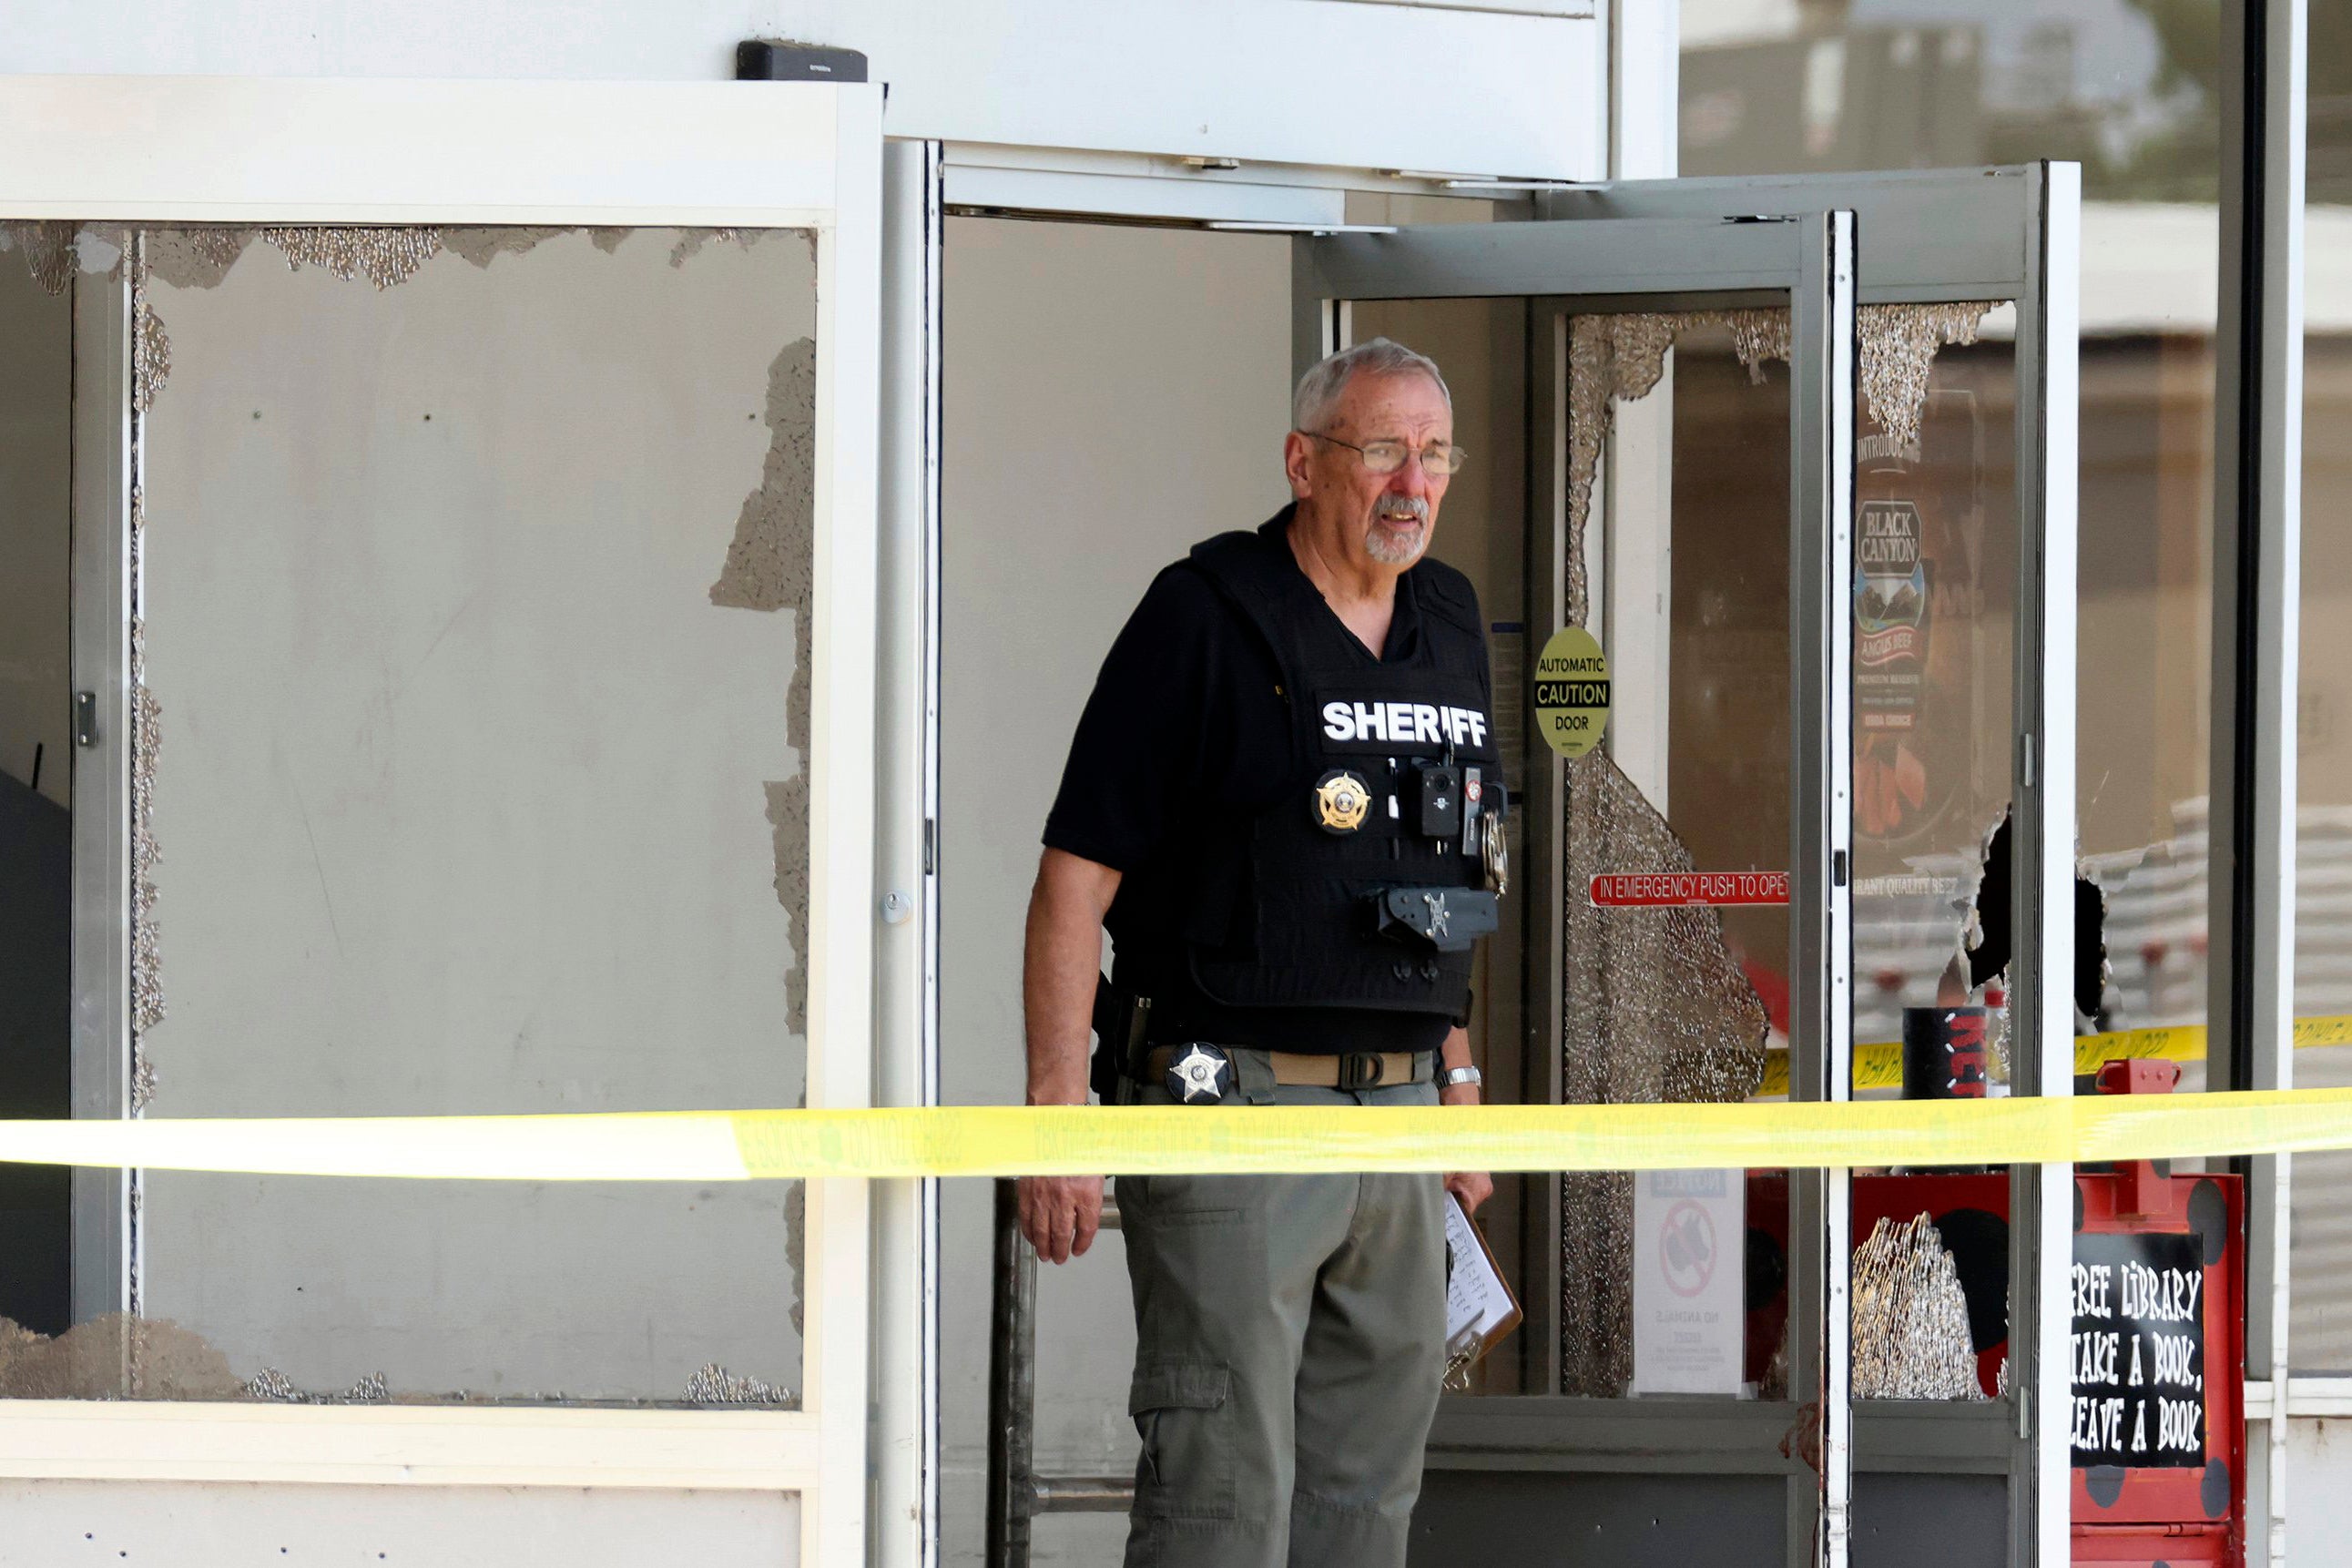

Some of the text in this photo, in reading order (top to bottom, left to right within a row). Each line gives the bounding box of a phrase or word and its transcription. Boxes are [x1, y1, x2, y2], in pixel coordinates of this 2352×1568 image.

[1857, 434, 1921, 463] INTRODUC
[1865, 512, 1912, 536] BLACK
[1860, 537, 1916, 563] CANYON
[1539, 657, 1604, 673] AUTOMATIC
[1536, 684, 1607, 705] CAUTION
[1322, 700, 1488, 748] SHERIFF
[1555, 716, 1589, 730] DOOR
[1600, 877, 1613, 898] IN
[1615, 876, 1696, 898] EMERGENCY
[1700, 875, 1736, 897] PUSH
[1738, 875, 1756, 896] TO
[1887, 877, 1929, 899] QUALITY
[2071, 1262, 2112, 1319] FREE
[2071, 1331, 2203, 1392] TAKE A BOOK,
[2131, 1399, 2147, 1452] A
[2157, 1396, 2202, 1452] BOOK
